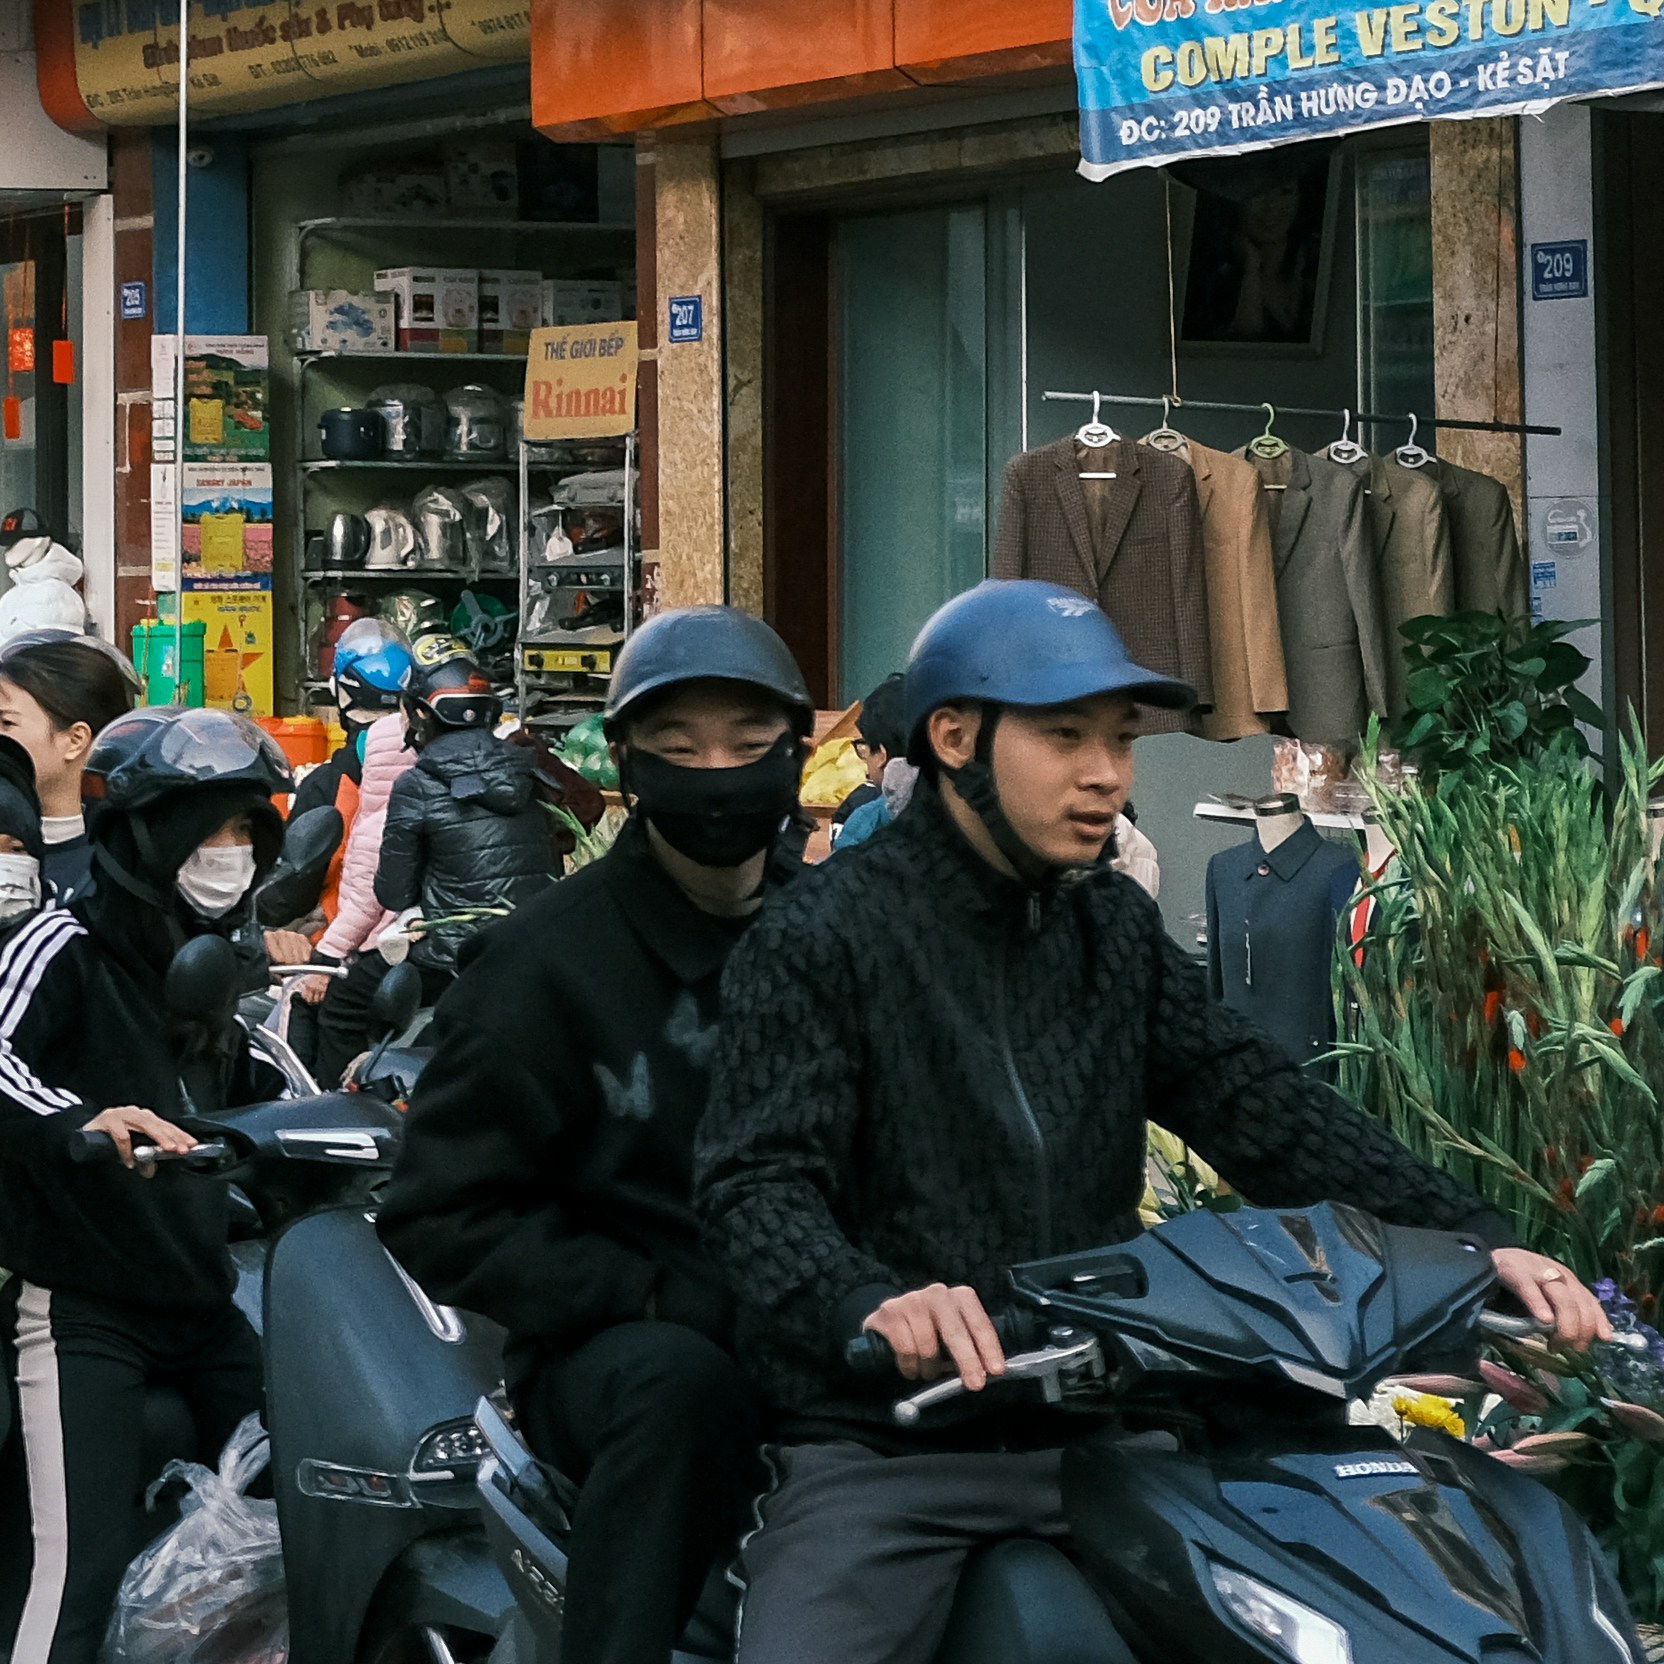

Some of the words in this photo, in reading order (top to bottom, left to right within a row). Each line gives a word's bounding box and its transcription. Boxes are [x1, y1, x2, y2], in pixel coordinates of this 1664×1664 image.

[1140, 15, 1340, 93] COMPLE
[1119, 117, 1167, 145] ĐC:
[1173, 106, 1219, 137] 209
[1227, 93, 1293, 129] TRẦN
[1301, 80, 1377, 117] HƯNG
[1386, 70, 1452, 109] ĐẠO
[1478, 51, 1509, 91] KẺ
[1517, 44, 1570, 89] SẶT
[1543, 253, 1573, 279] 209
[675, 305, 694, 326] 207
[544, 333, 567, 361] THẾ
[569, 332, 597, 359] GIỚI
[598, 330, 624, 357] BẾP
[532, 373, 627, 419] Rinnai
[1335, 1459, 1420, 1481] HONDA
